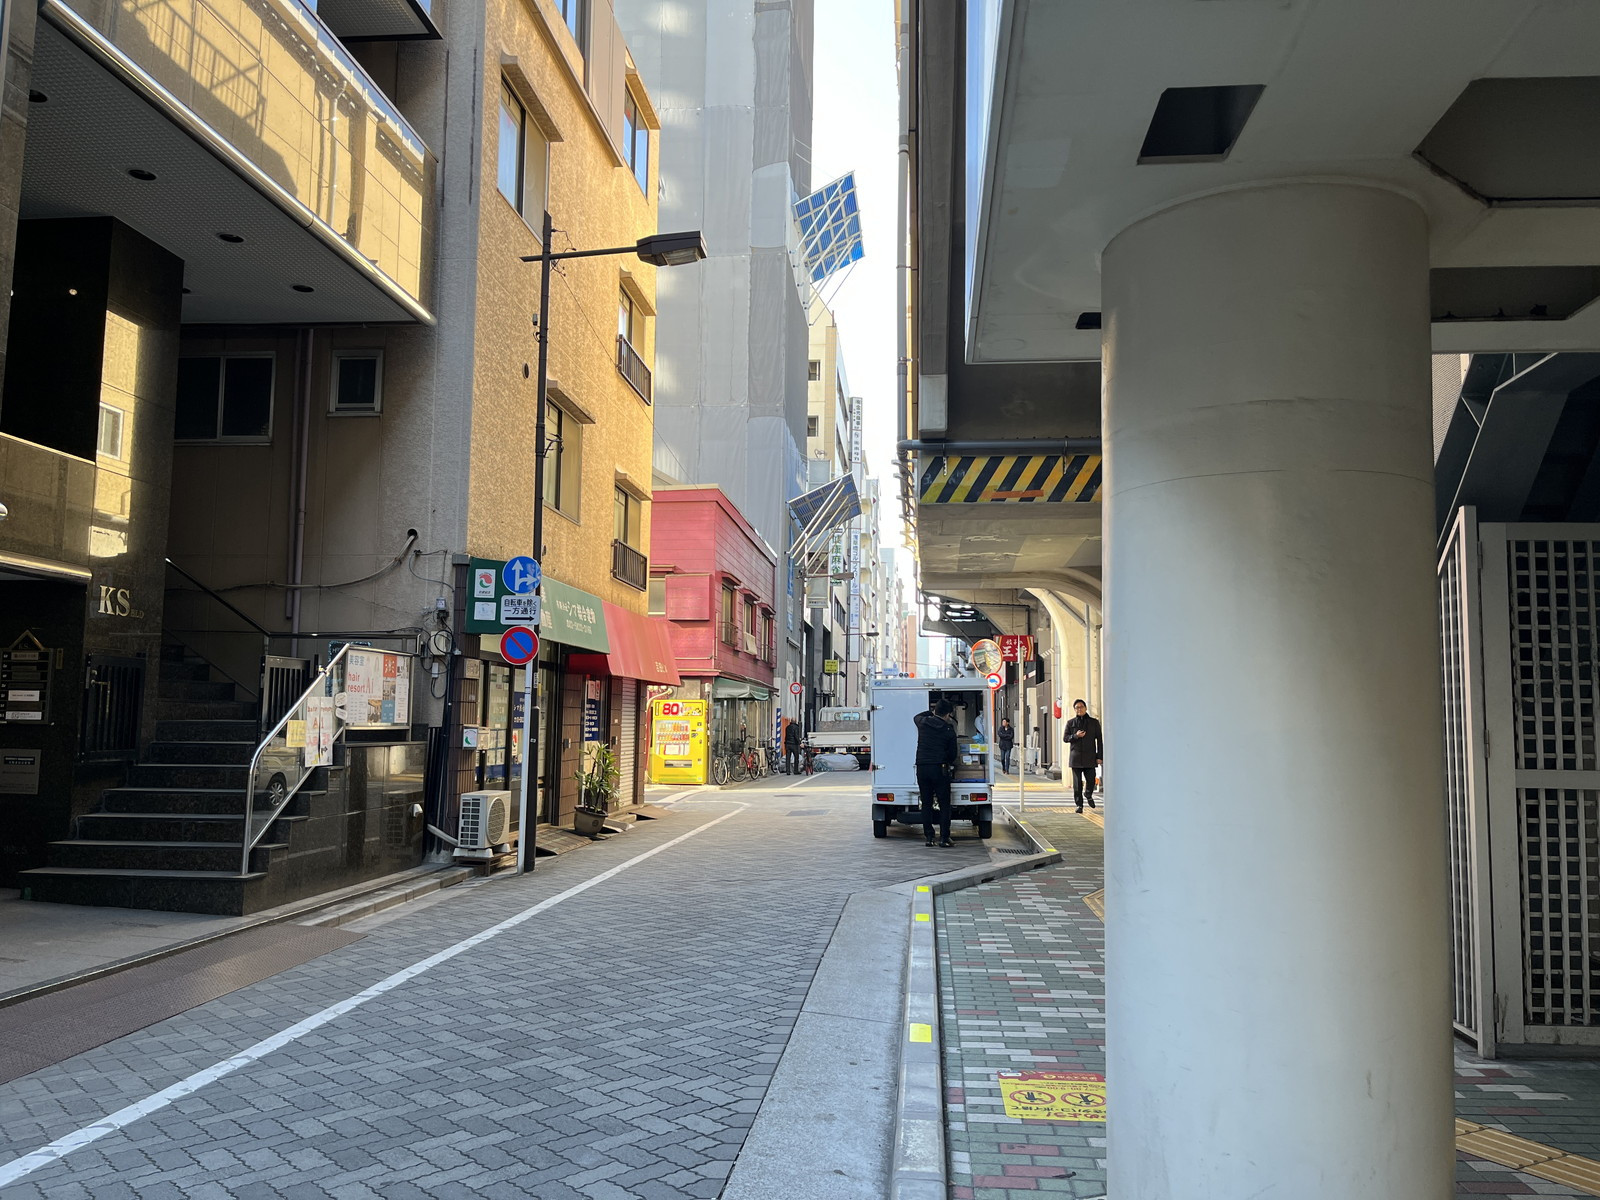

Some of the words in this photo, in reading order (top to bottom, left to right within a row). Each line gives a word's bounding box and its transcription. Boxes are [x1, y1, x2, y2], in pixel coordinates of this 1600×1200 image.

[97, 585, 131, 617] KS
[504, 598, 537, 607] 自転車を除く
[504, 607, 537, 615] 一方通行
[347, 671, 360, 682] hair
[347, 683, 366, 693] resort
[662, 703, 680, 716] 80
